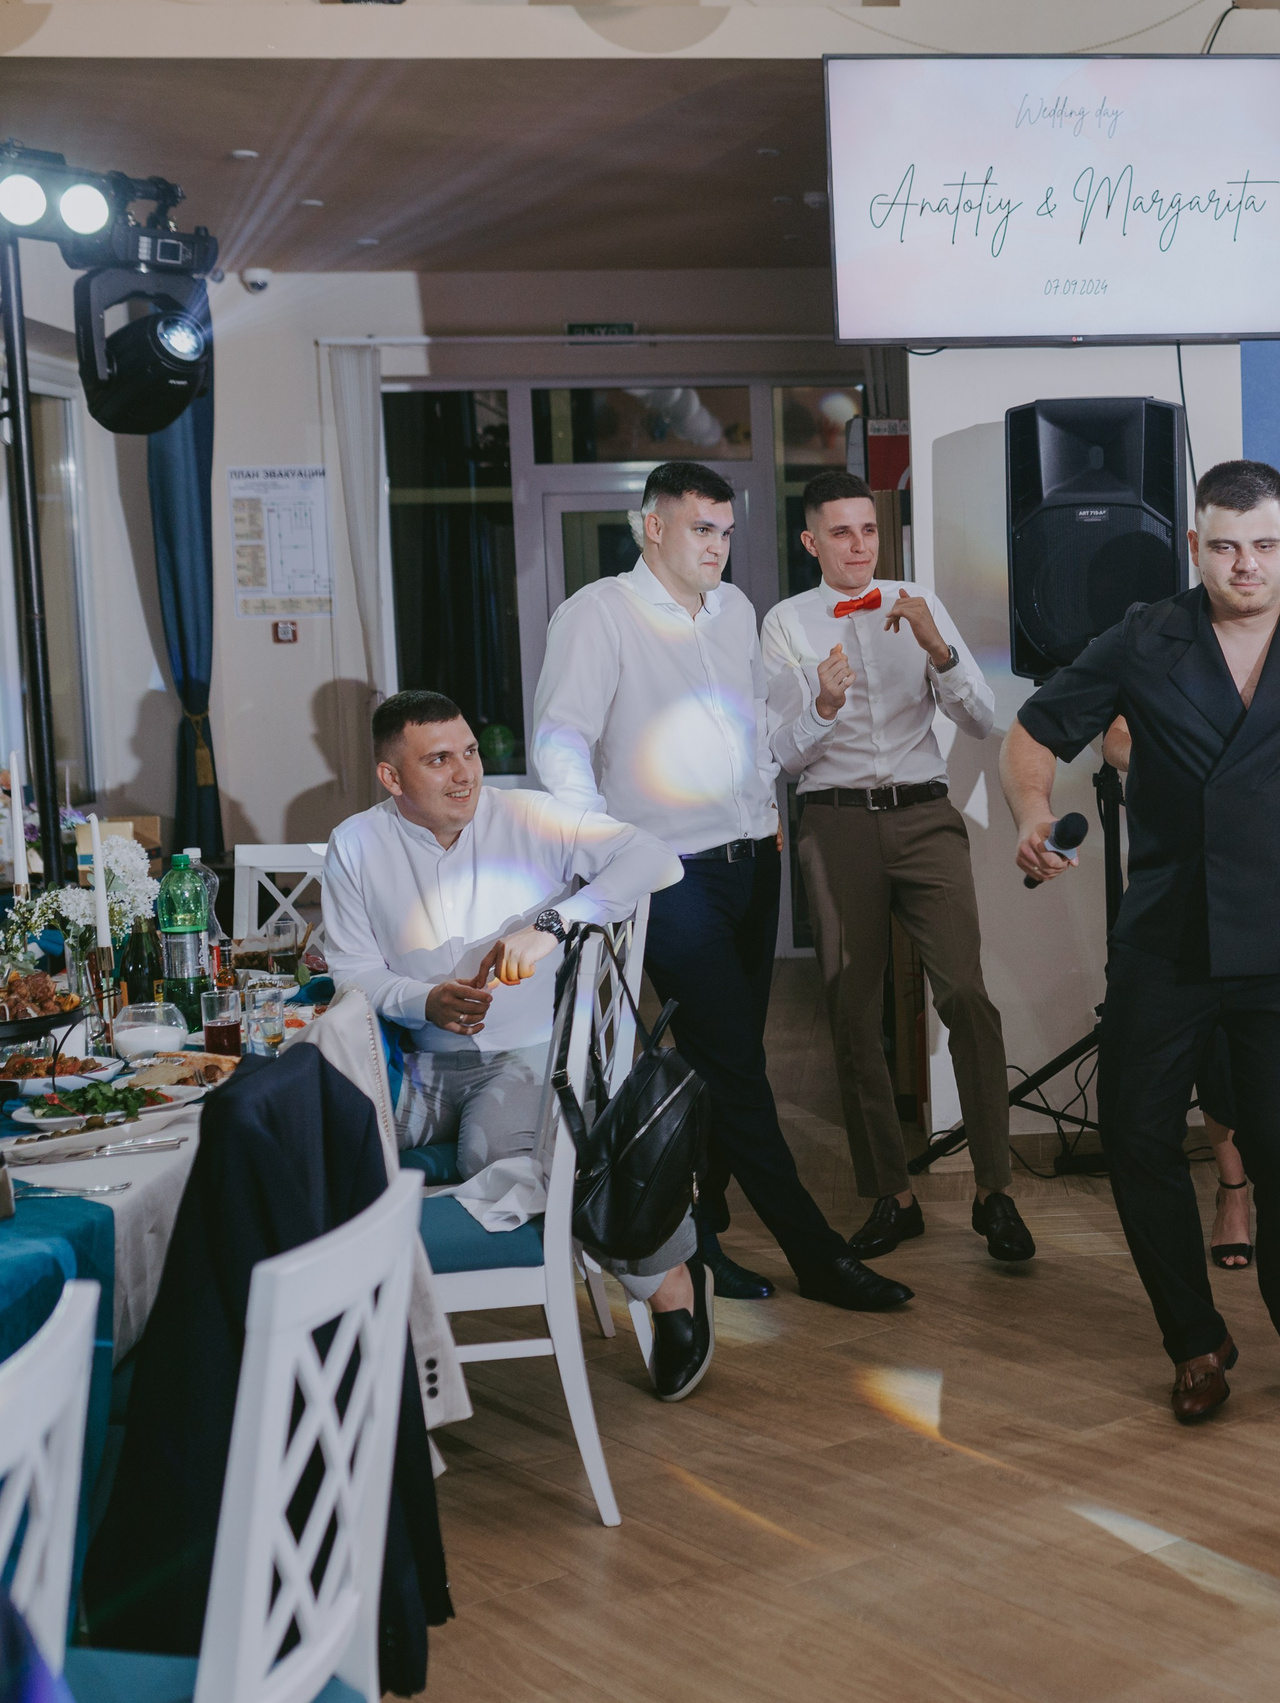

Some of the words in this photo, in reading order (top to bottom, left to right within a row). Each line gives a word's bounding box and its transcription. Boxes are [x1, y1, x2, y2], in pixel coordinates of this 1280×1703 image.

[1014, 93, 1089, 137] Wedding
[1094, 96, 1125, 139] day
[870, 164, 1023, 257] Anatoliy
[1036, 186, 1058, 218] &
[1073, 164, 1280, 252] Margarita
[1043, 278, 1109, 296] 07.09.2024
[230, 470, 259, 480] ПЛАН
